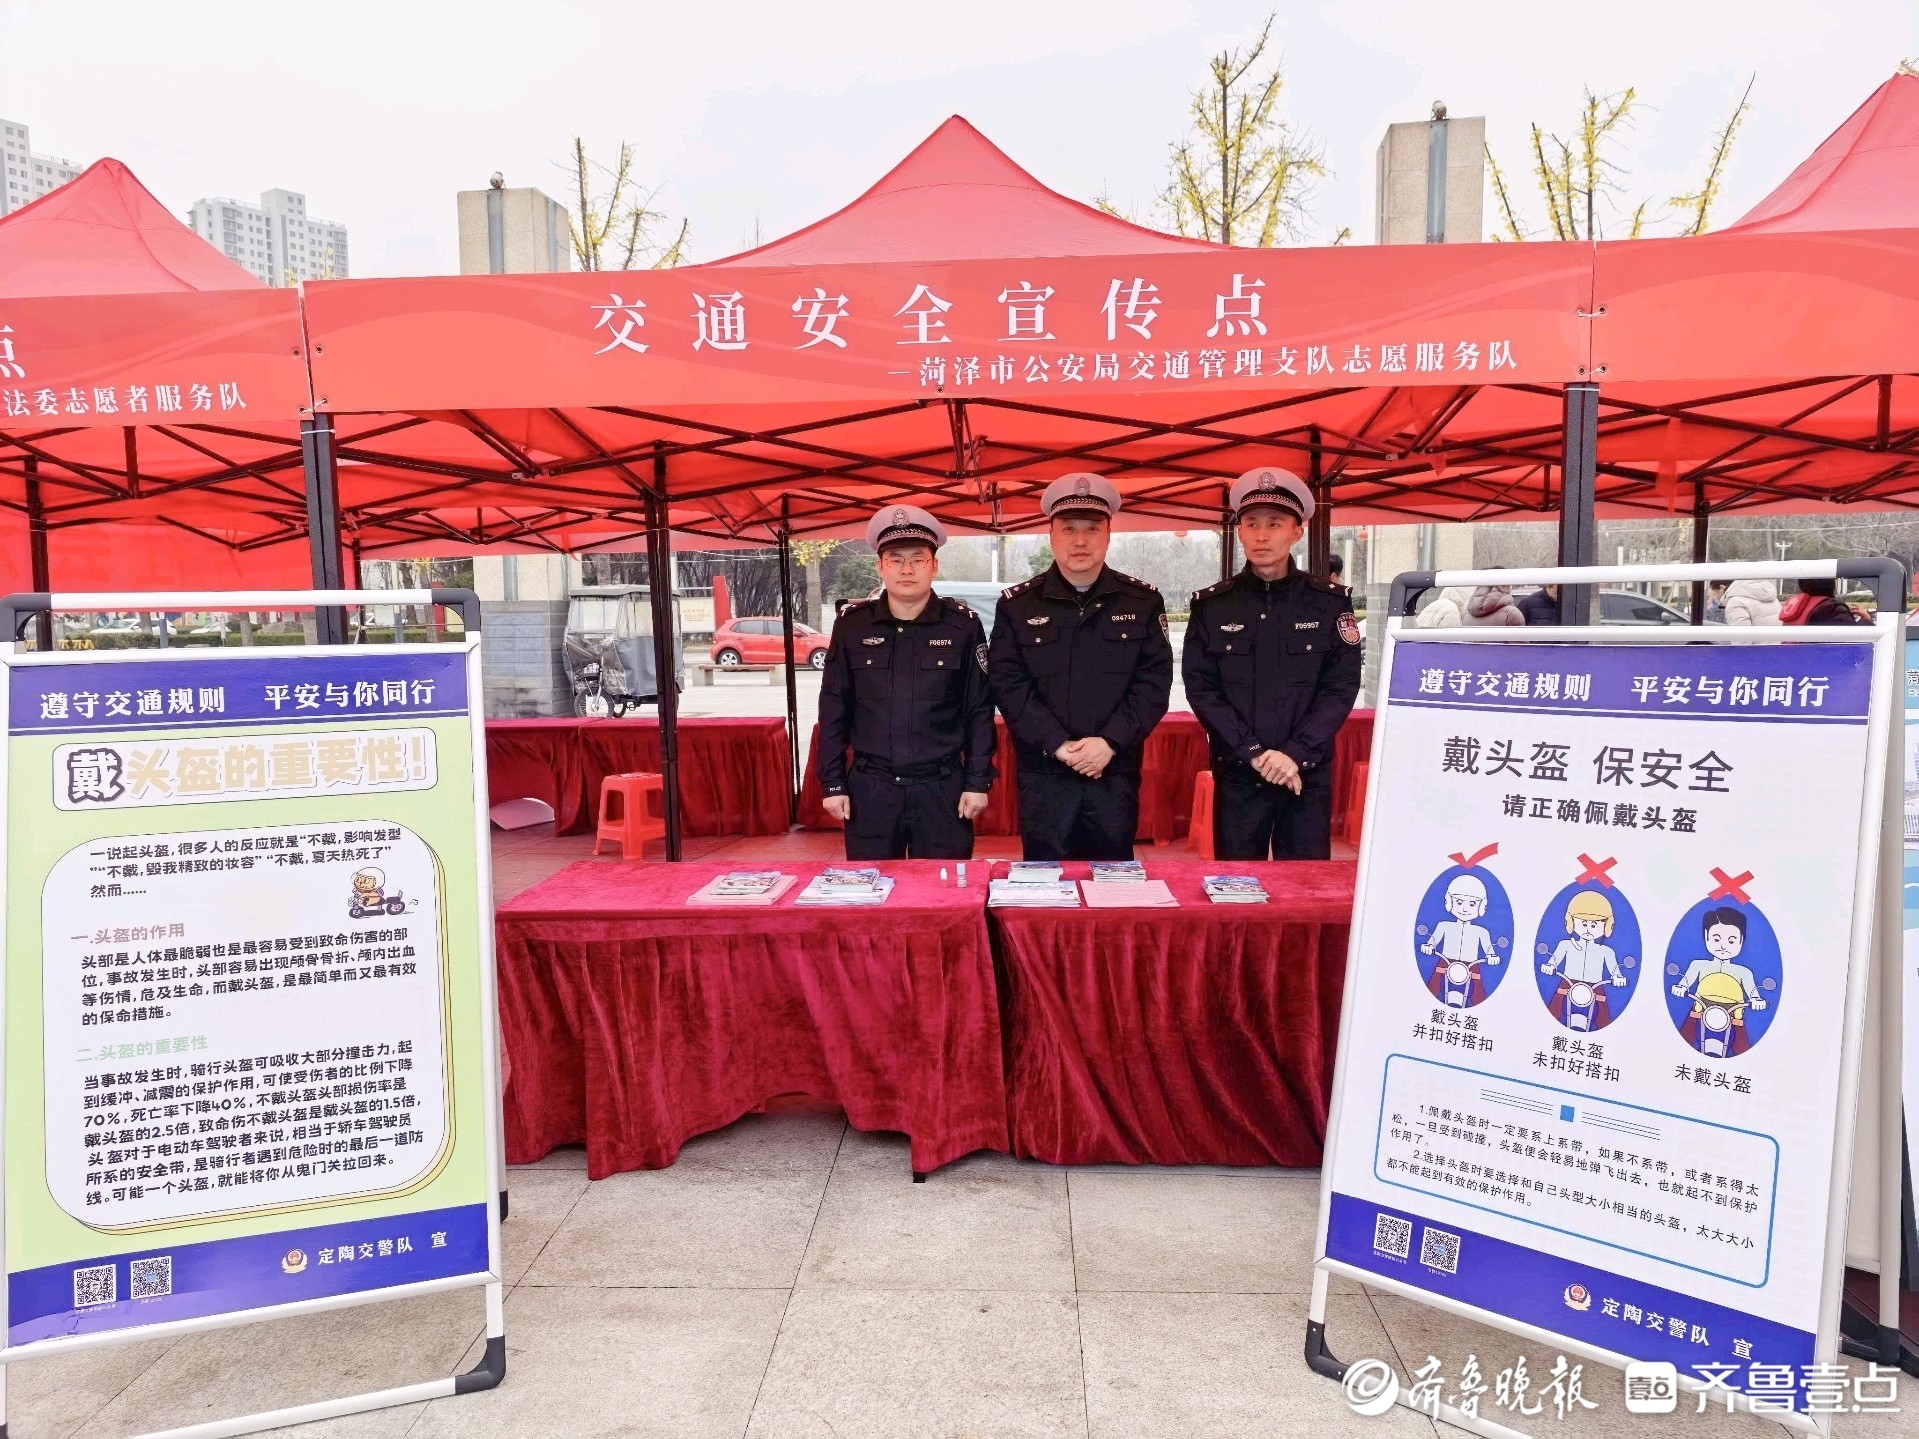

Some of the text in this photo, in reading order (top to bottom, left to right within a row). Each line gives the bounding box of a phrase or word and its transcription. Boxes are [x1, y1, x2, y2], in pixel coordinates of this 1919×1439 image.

[590, 273, 1268, 356] 交通安全宣传点
[40, 678, 437, 721] 遵守交通规则 平安与你同行
[1418, 667, 1831, 708] 遵守交通规则 平安与你同行
[1441, 735, 1735, 794] 戴头盔 保安全
[1501, 793, 1698, 834] 请正确佩戴头盔
[81, 927, 409, 970] 头部是人体最脆弱也是最容易受到致命伤害的部
[81, 1005, 173, 1027] 的保命措施。
[1430, 1008, 1479, 1032] 戴头盔
[1413, 1023, 1494, 1053] 并扣好搭扣
[1552, 1035, 1604, 1060] 戴头盔
[1533, 1051, 1621, 1083] 未扣好搭扣
[1674, 1063, 1753, 1094] 未戴头盔
[317, 1231, 448, 1266] 定陶交警队 宣
[1600, 1296, 1754, 1361] 定陶交警队 宣
